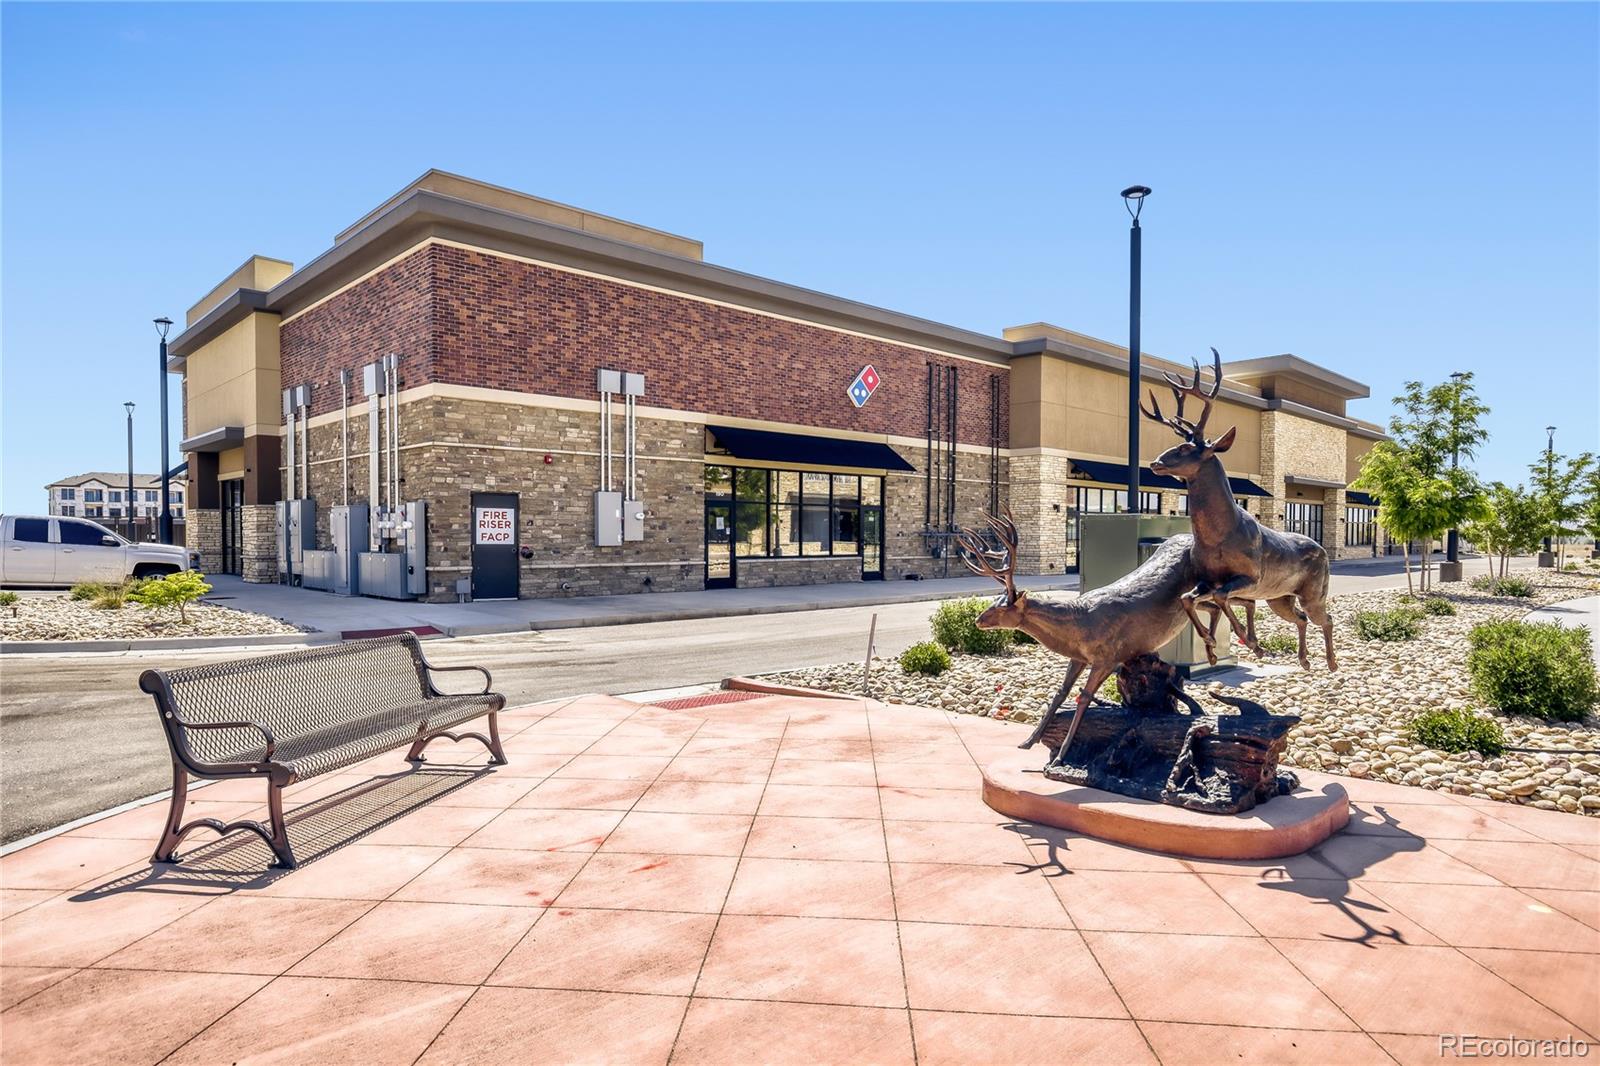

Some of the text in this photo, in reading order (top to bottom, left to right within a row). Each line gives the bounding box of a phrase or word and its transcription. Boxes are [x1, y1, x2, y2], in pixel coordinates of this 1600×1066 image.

[483, 511, 507, 520] FIRE
[479, 520, 511, 529] RISER
[481, 532, 510, 541] FACP
